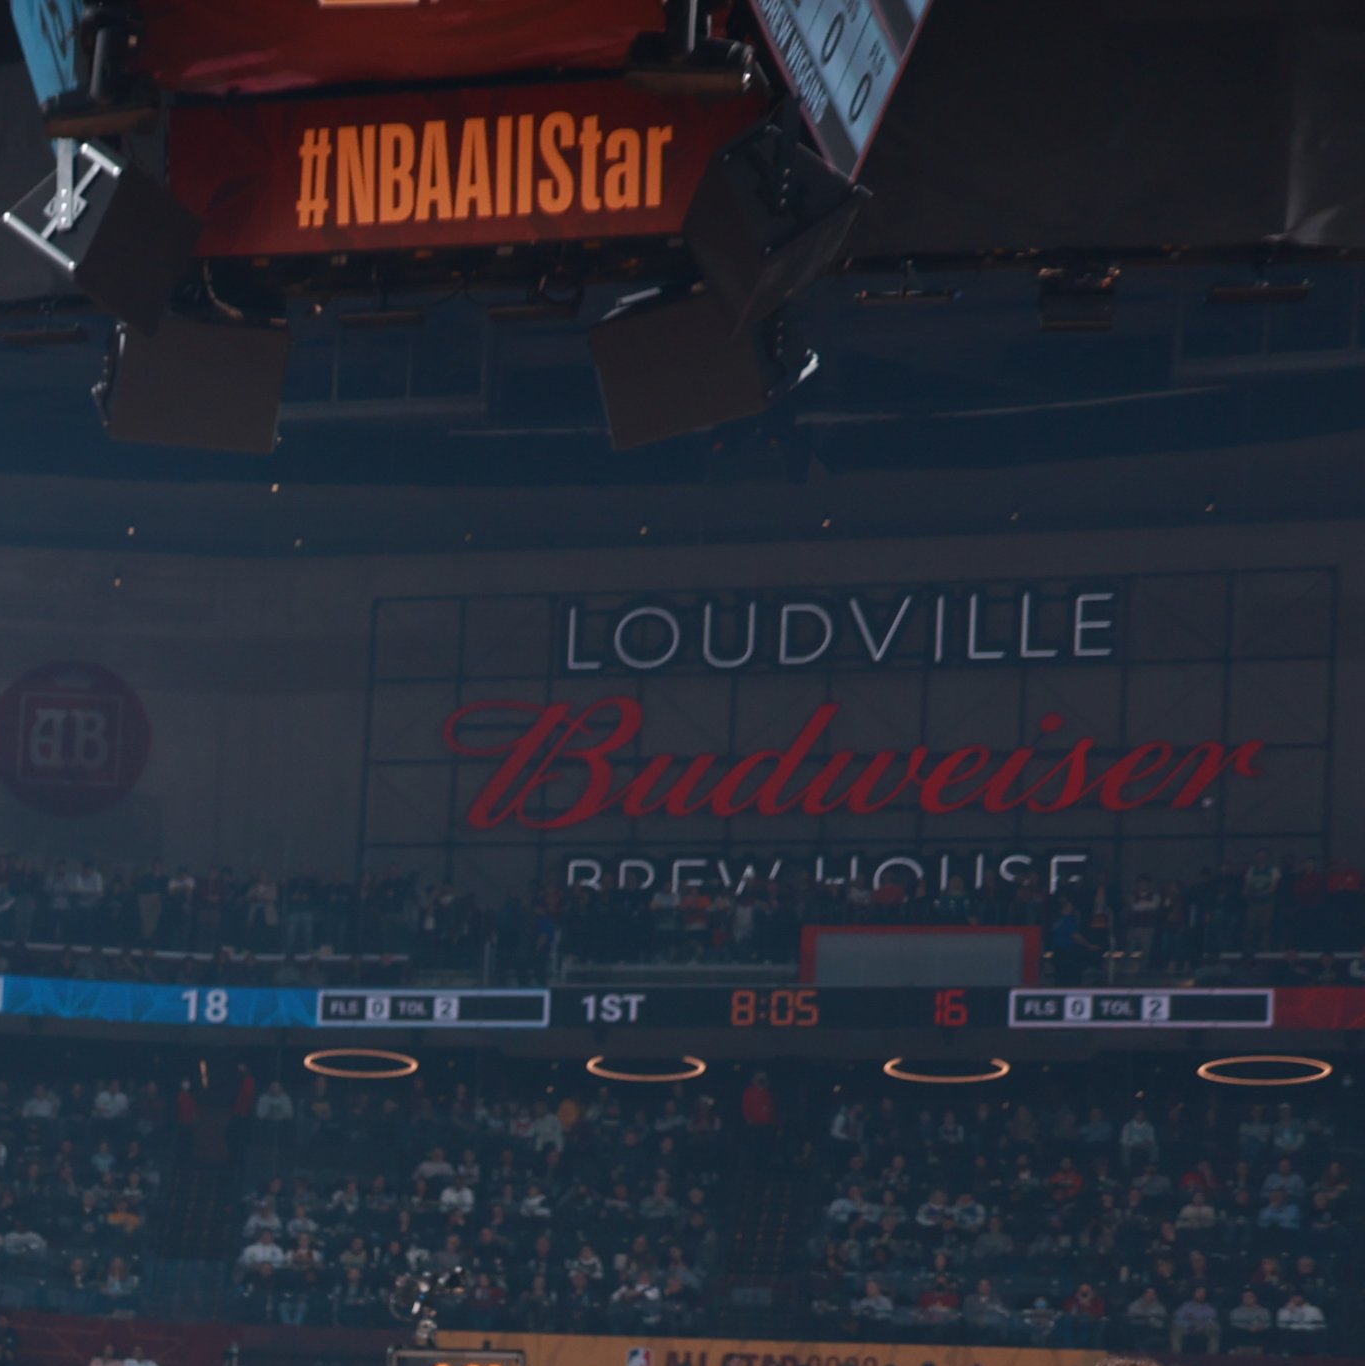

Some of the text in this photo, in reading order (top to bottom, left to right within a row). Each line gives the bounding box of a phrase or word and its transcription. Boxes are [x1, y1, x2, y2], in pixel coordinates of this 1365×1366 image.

[295, 111, 672, 229] #NBAAllStar
[567, 592, 1115, 670] LOUDVILLE
[444, 695, 1265, 831] Budweiser
[181, 989, 229, 1023] 18
[329, 1000, 427, 1016] FLS TOL
[581, 990, 967, 1027] 1ST 8:05 16
[1024, 1000, 1057, 1016] FLS
[1099, 1000, 1133, 1016] TOL
